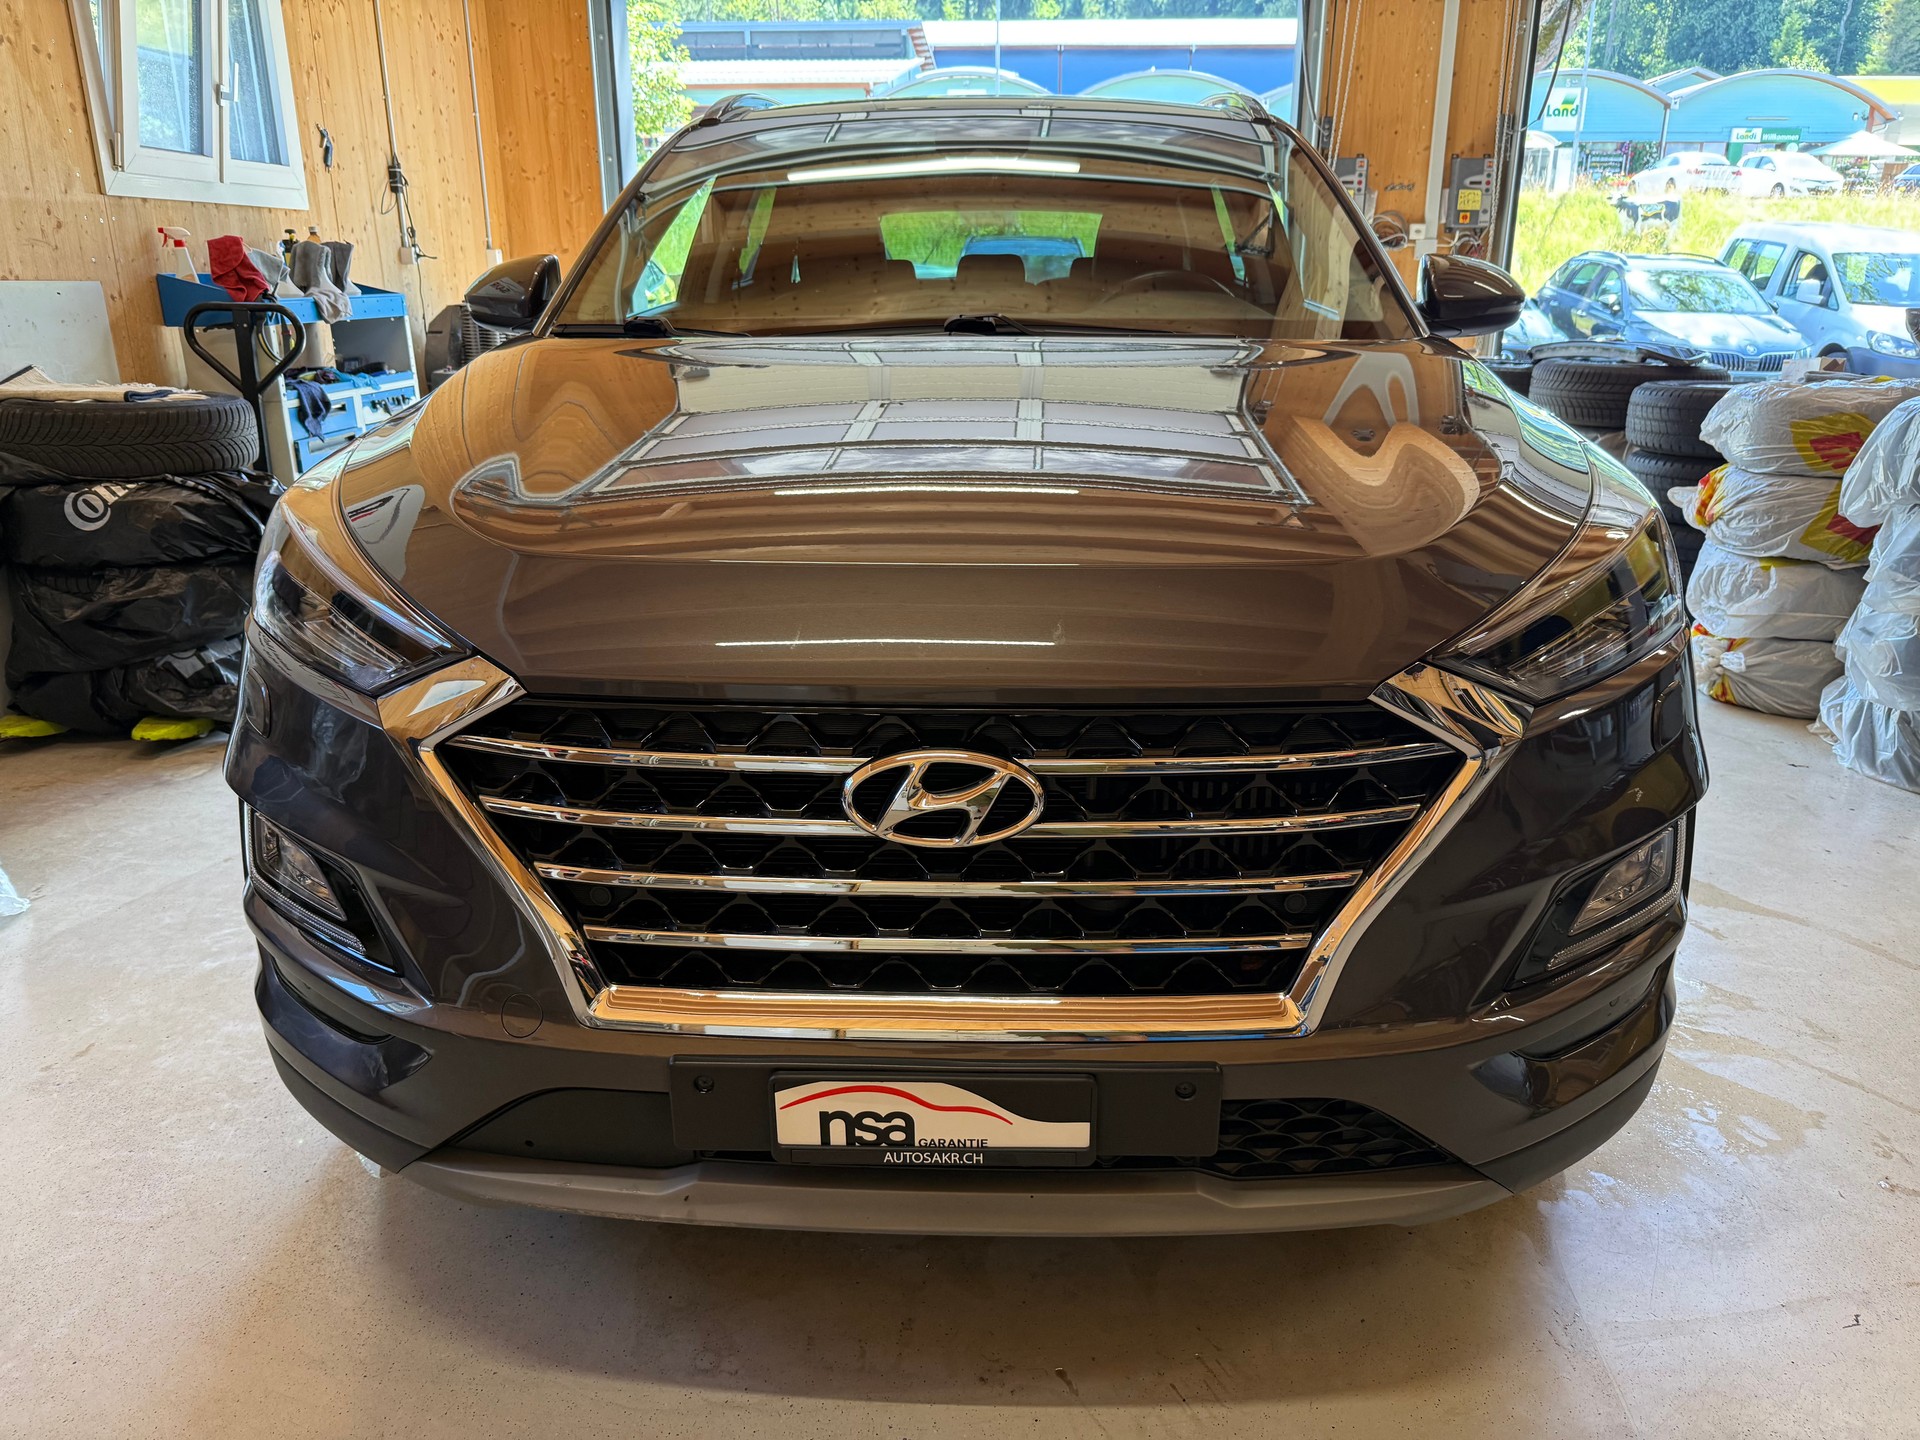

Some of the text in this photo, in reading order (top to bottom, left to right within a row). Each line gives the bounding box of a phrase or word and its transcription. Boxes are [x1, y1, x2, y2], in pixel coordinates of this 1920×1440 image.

[1546, 104, 1581, 117] Land
[1762, 133, 1799, 141] Willkommen
[819, 1111, 989, 1148] nsa GARANTIE
[883, 1152, 984, 1165] AUTOSAKR.CH
